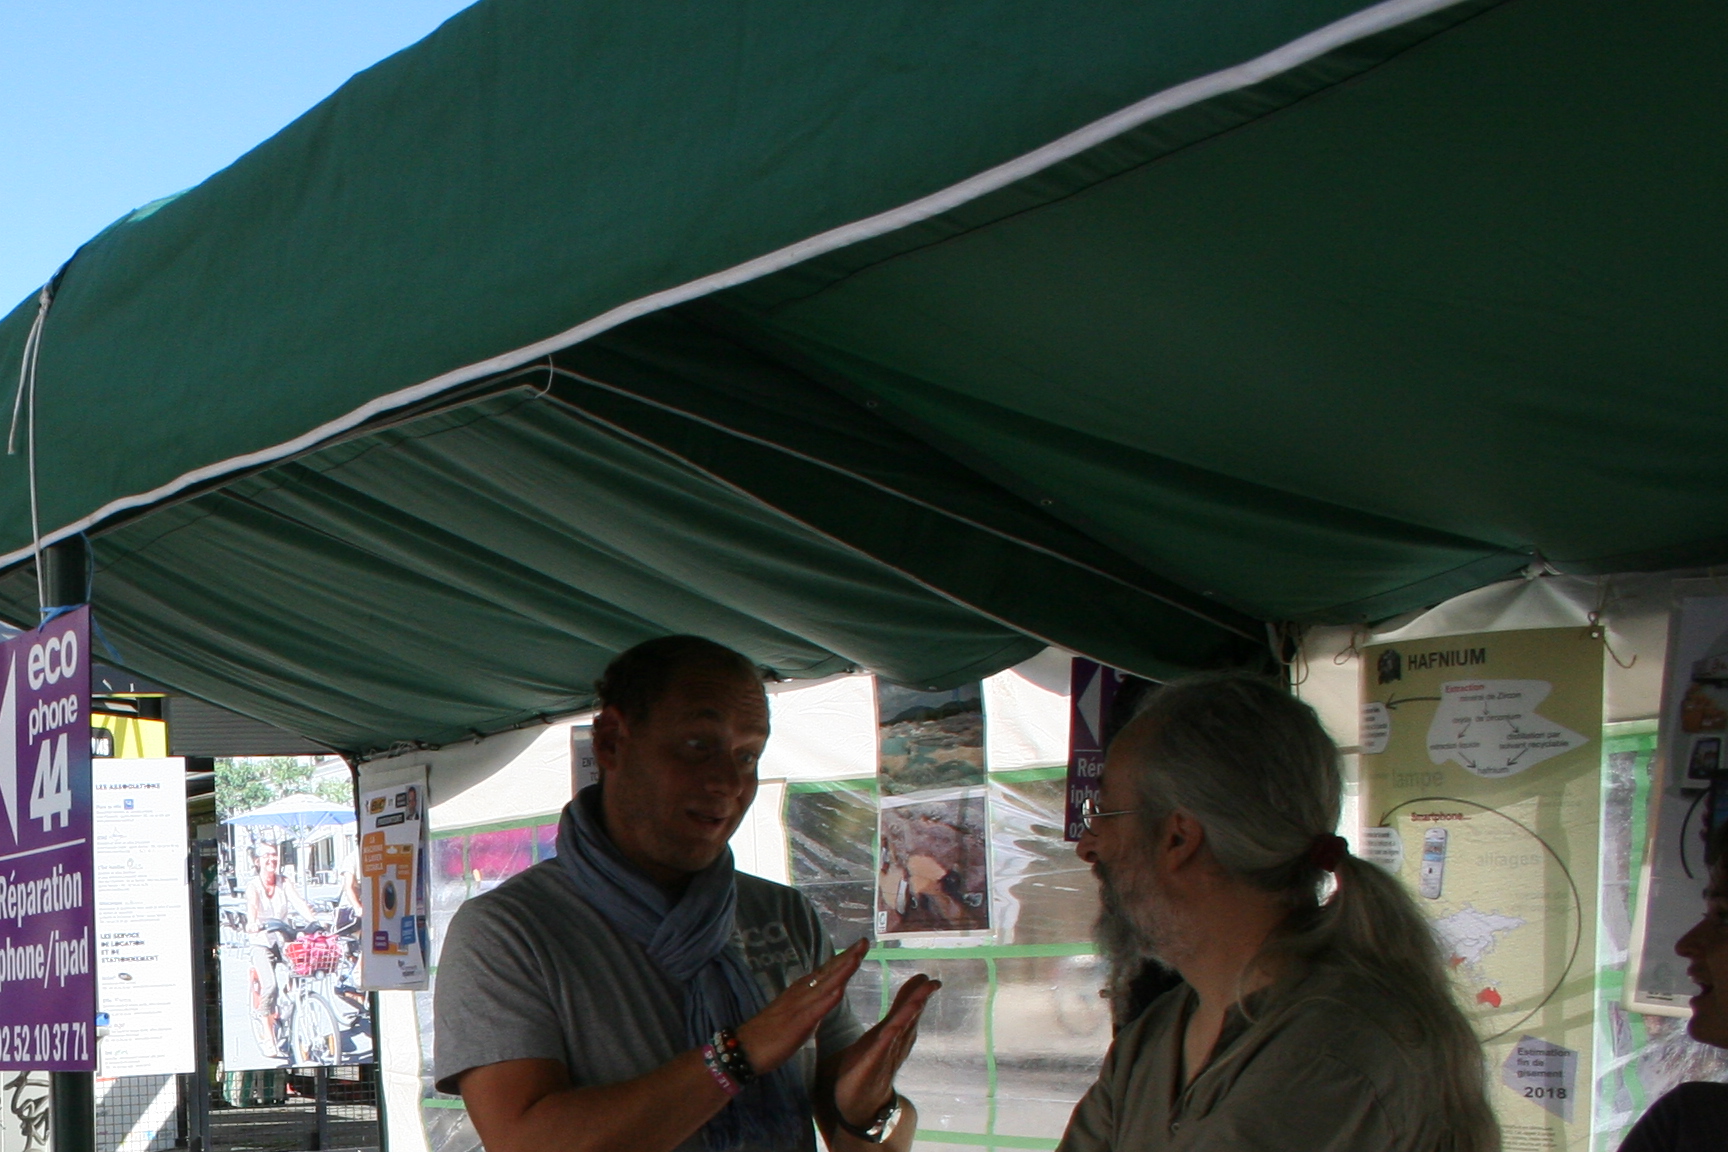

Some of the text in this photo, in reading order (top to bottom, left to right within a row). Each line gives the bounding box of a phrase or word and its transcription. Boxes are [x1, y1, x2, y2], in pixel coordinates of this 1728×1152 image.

[28, 630, 78, 691] eco
[1408, 648, 1486, 671] HAFNIUM
[29, 694, 78, 746] phone
[29, 733, 72, 833] 44
[13, 1024, 30, 1062] 52
[34, 1023, 50, 1062] 10
[53, 1022, 69, 1061] 37
[72, 1021, 89, 1061] 71
[1517, 1047, 1570, 1057] Estimation
[1516, 1058, 1544, 1067] fin de
[1516, 1069, 1563, 1079] gisement
[1524, 1087, 1567, 1100] 2018
